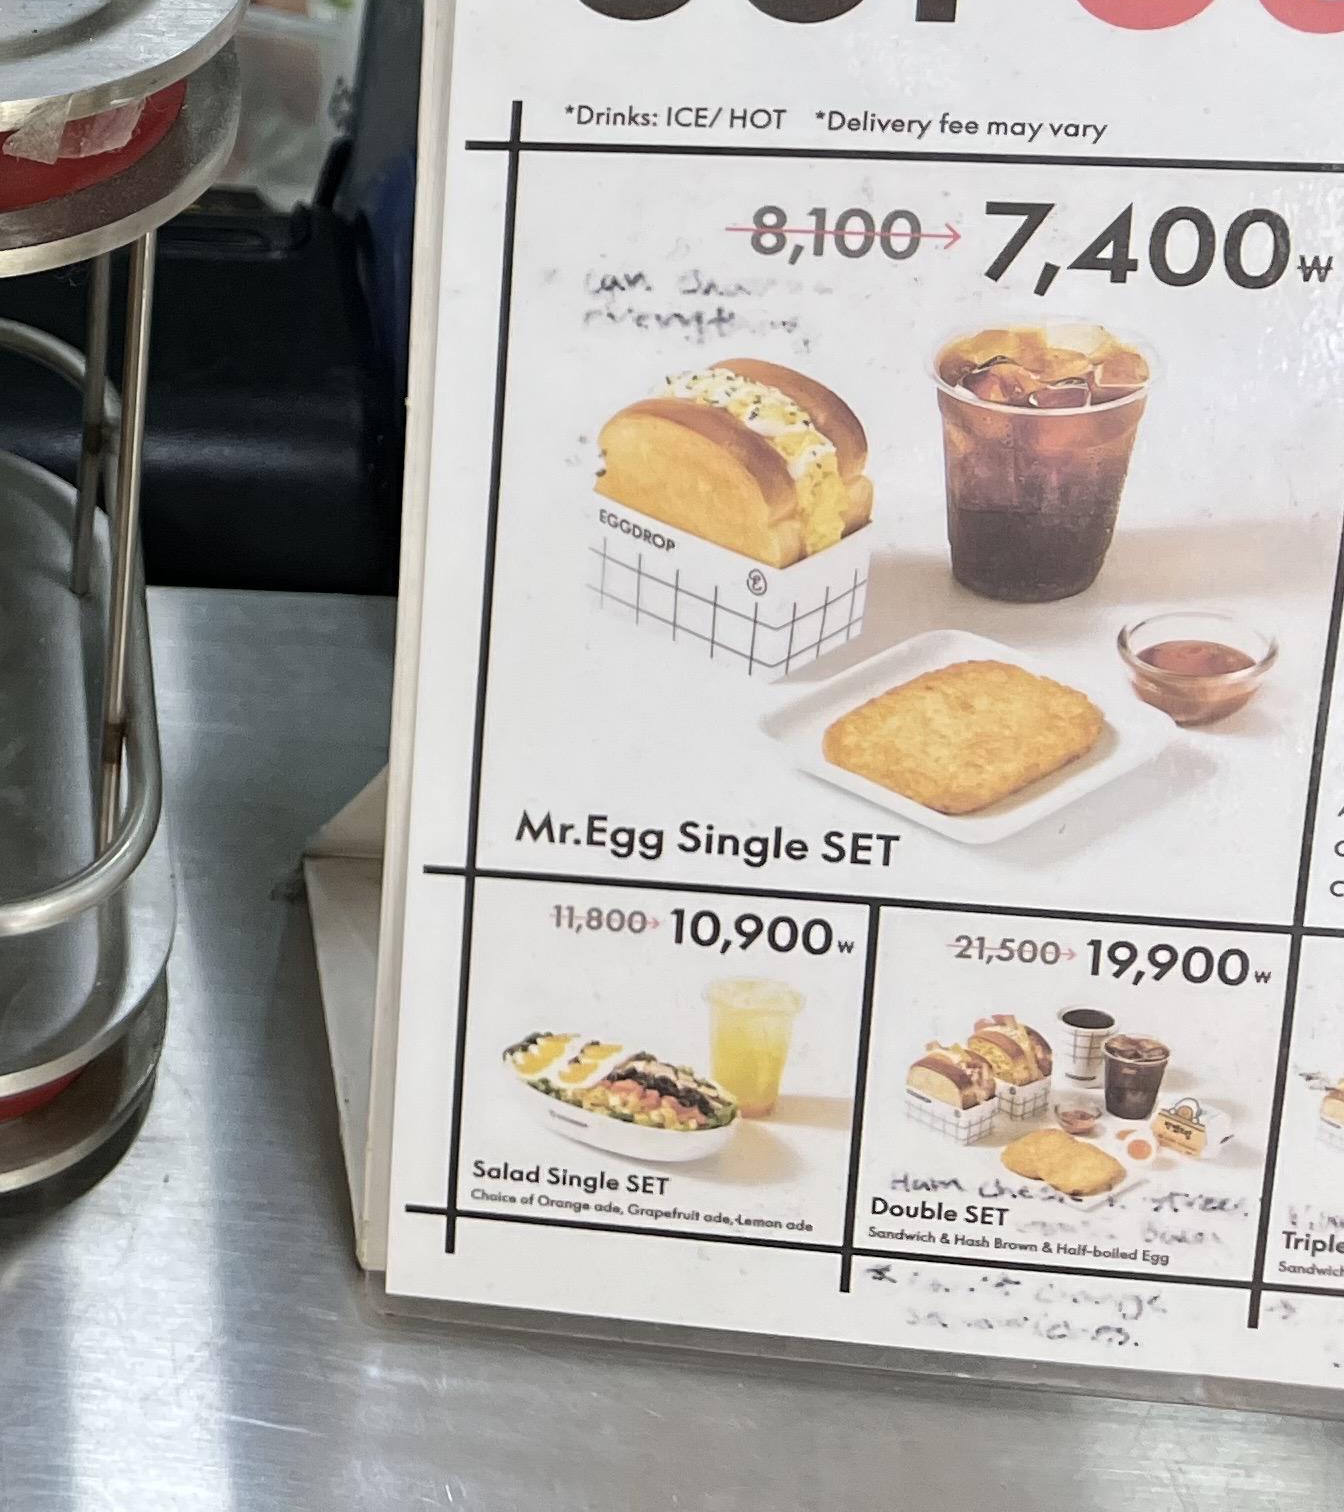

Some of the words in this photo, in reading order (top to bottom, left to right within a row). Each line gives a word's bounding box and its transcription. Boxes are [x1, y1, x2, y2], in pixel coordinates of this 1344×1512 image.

[729, 108, 787, 130] HOT
[938, 112, 980, 136] fee
[986, 119, 1044, 142] may
[1049, 120, 1108, 144] vary
[750, 204, 922, 265] 8,100
[597, 508, 676, 553] EGGDROP
[514, 809, 664, 861] Mr.Egg
[676, 820, 810, 868] Single
[821, 830, 901, 867] SET
[551, 903, 647, 934] 11,800
[953, 934, 1061, 966] 21,500
[472, 1159, 541, 1184] Salad
[546, 1166, 620, 1194] Single
[626, 1174, 670, 1196] SET
[470, 1188, 517, 1204] Choice
[520, 1193, 535, 1206] of
[537, 1194, 591, 1214] Orange
[627, 1203, 700, 1221] Grapefruit
[785, 1221, 814, 1233] ade
[871, 1196, 958, 1222] Double
[964, 1205, 1010, 1226] SET
[868, 1226, 936, 1244] Sandwich
[939, 1232, 951, 1245] &
[954, 1234, 990, 1249] Hash
[994, 1237, 1038, 1253] Brown
[1041, 1242, 1053, 1254] &
[1056, 1242, 1138, 1261] Half-boiled
[1142, 1249, 1170, 1266] Egg
